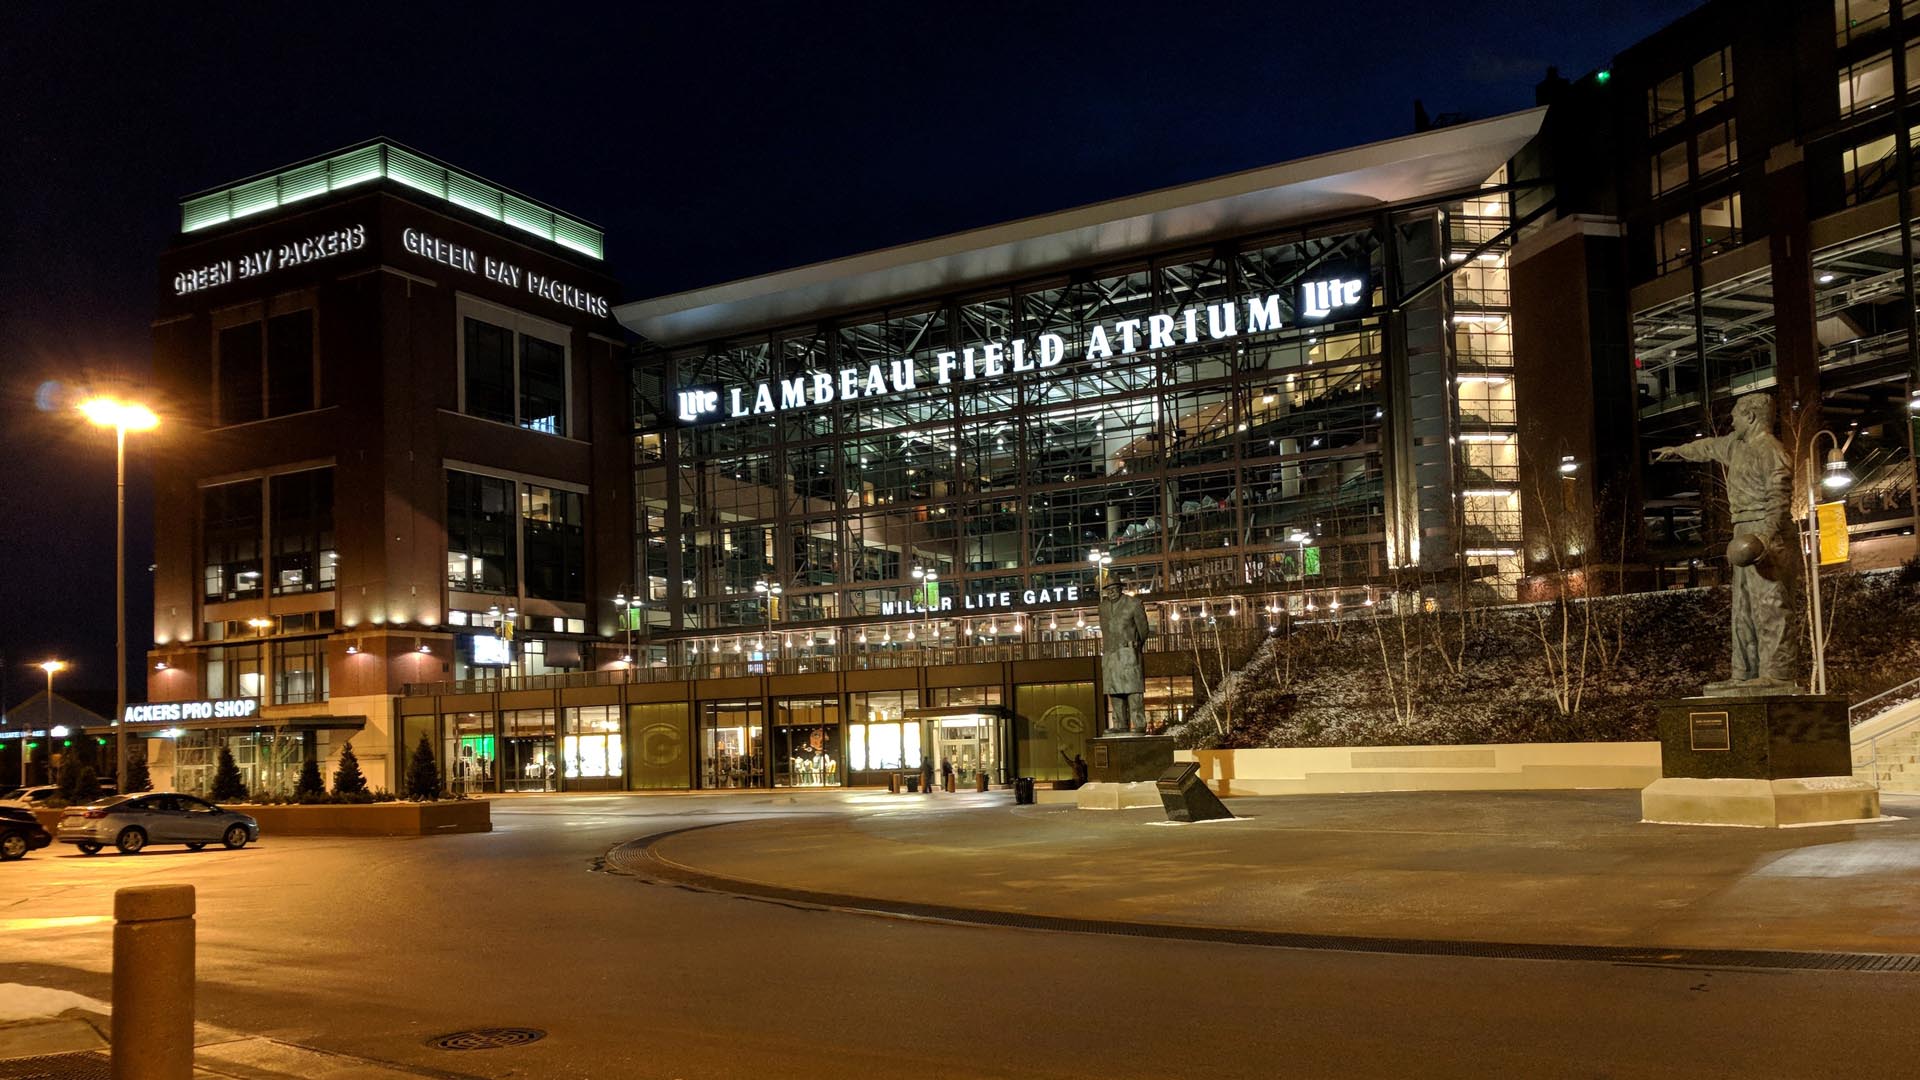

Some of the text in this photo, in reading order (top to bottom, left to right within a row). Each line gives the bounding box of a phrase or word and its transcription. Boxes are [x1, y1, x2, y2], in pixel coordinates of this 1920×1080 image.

[174, 224, 366, 296] GREEN BAY PACKERS
[402, 227, 608, 319] GREEN BAY PACKERS
[678, 278, 1363, 421] Lite LAMBEAU FIELD ATRIUM Lite
[965, 592, 1011, 609] LITE
[1023, 586, 1079, 605] GATE
[124, 699, 256, 723] ACKERS PRO SHOP
